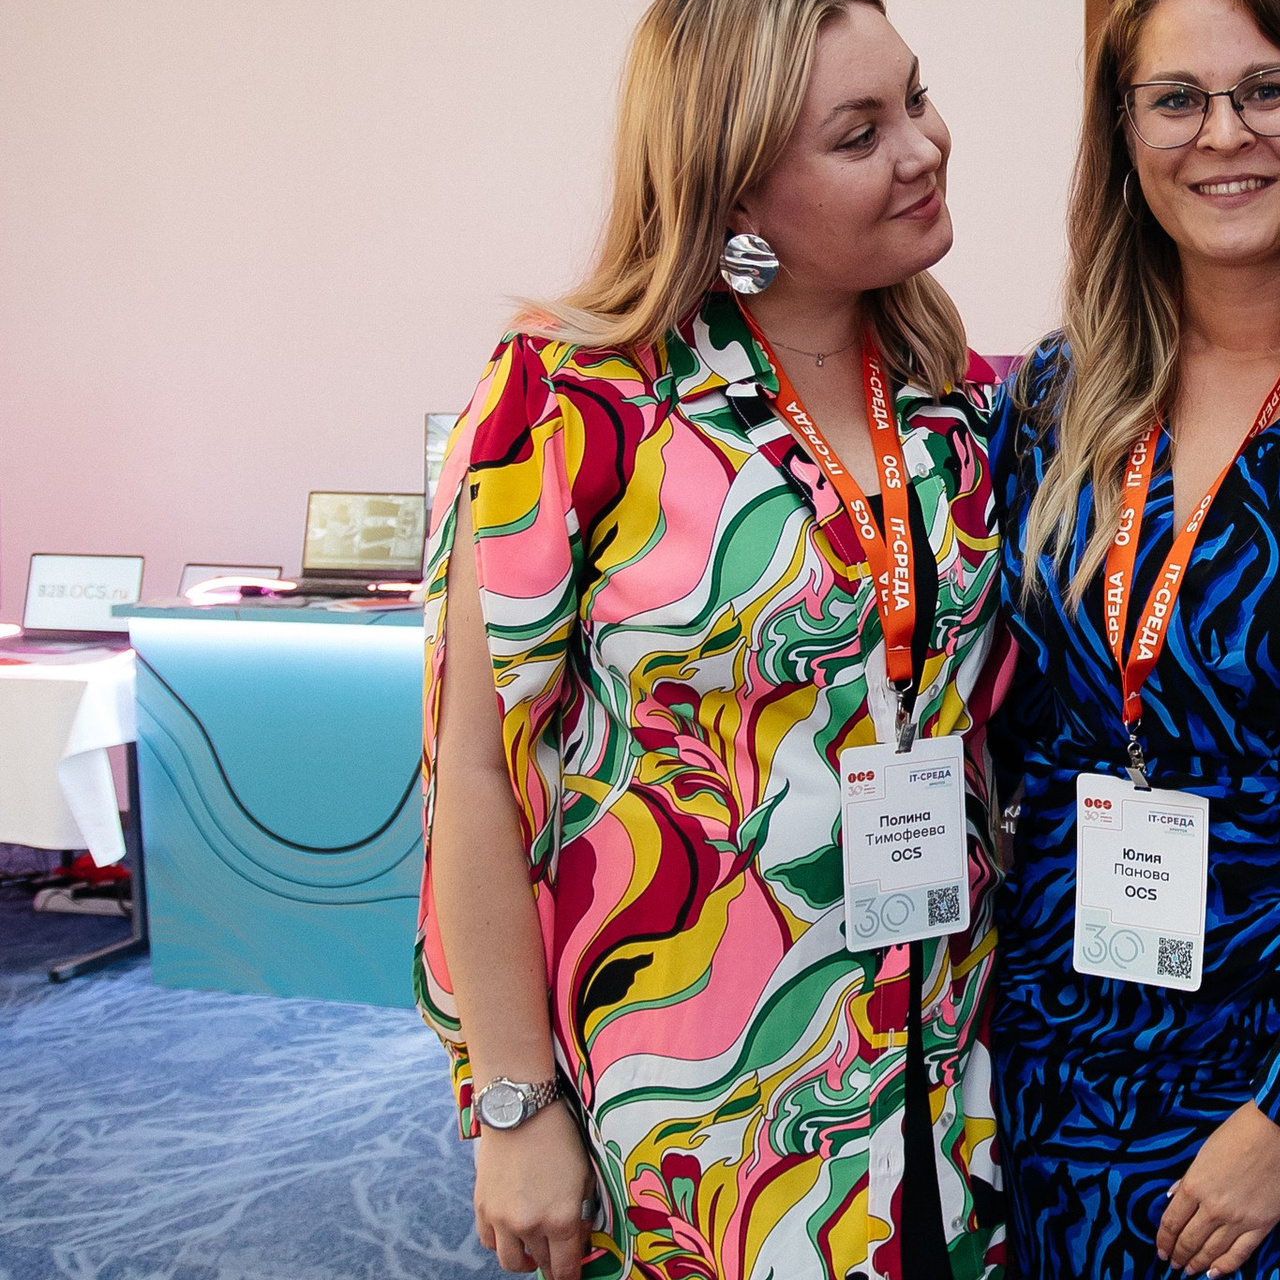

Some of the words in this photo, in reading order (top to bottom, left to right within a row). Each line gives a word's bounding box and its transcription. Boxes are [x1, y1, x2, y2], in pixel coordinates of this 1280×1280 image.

[786, 401, 844, 476] IT-СРЕДА
[883, 454, 902, 489] OCS
[850, 499, 876, 540] OCS
[1114, 508, 1135, 546] OCS
[1186, 494, 1212, 533] OCS
[890, 517, 910, 612] IT-СРЕДА
[1136, 563, 1182, 662] IT-СРЕДА
[909, 769, 952, 783] IT-СРЕДА
[865, 825, 946, 846] Тимофеева
[879, 811, 931, 828] Полина
[1148, 814, 1195, 828] IT-СРЕДА
[891, 846, 923, 862] OCS
[1114, 862, 1170, 881] Панова
[1122, 848, 1162, 865] Юлия
[1124, 885, 1158, 901] OCS
[854, 893, 915, 939] 30
[1082, 922, 1145, 970] 30
